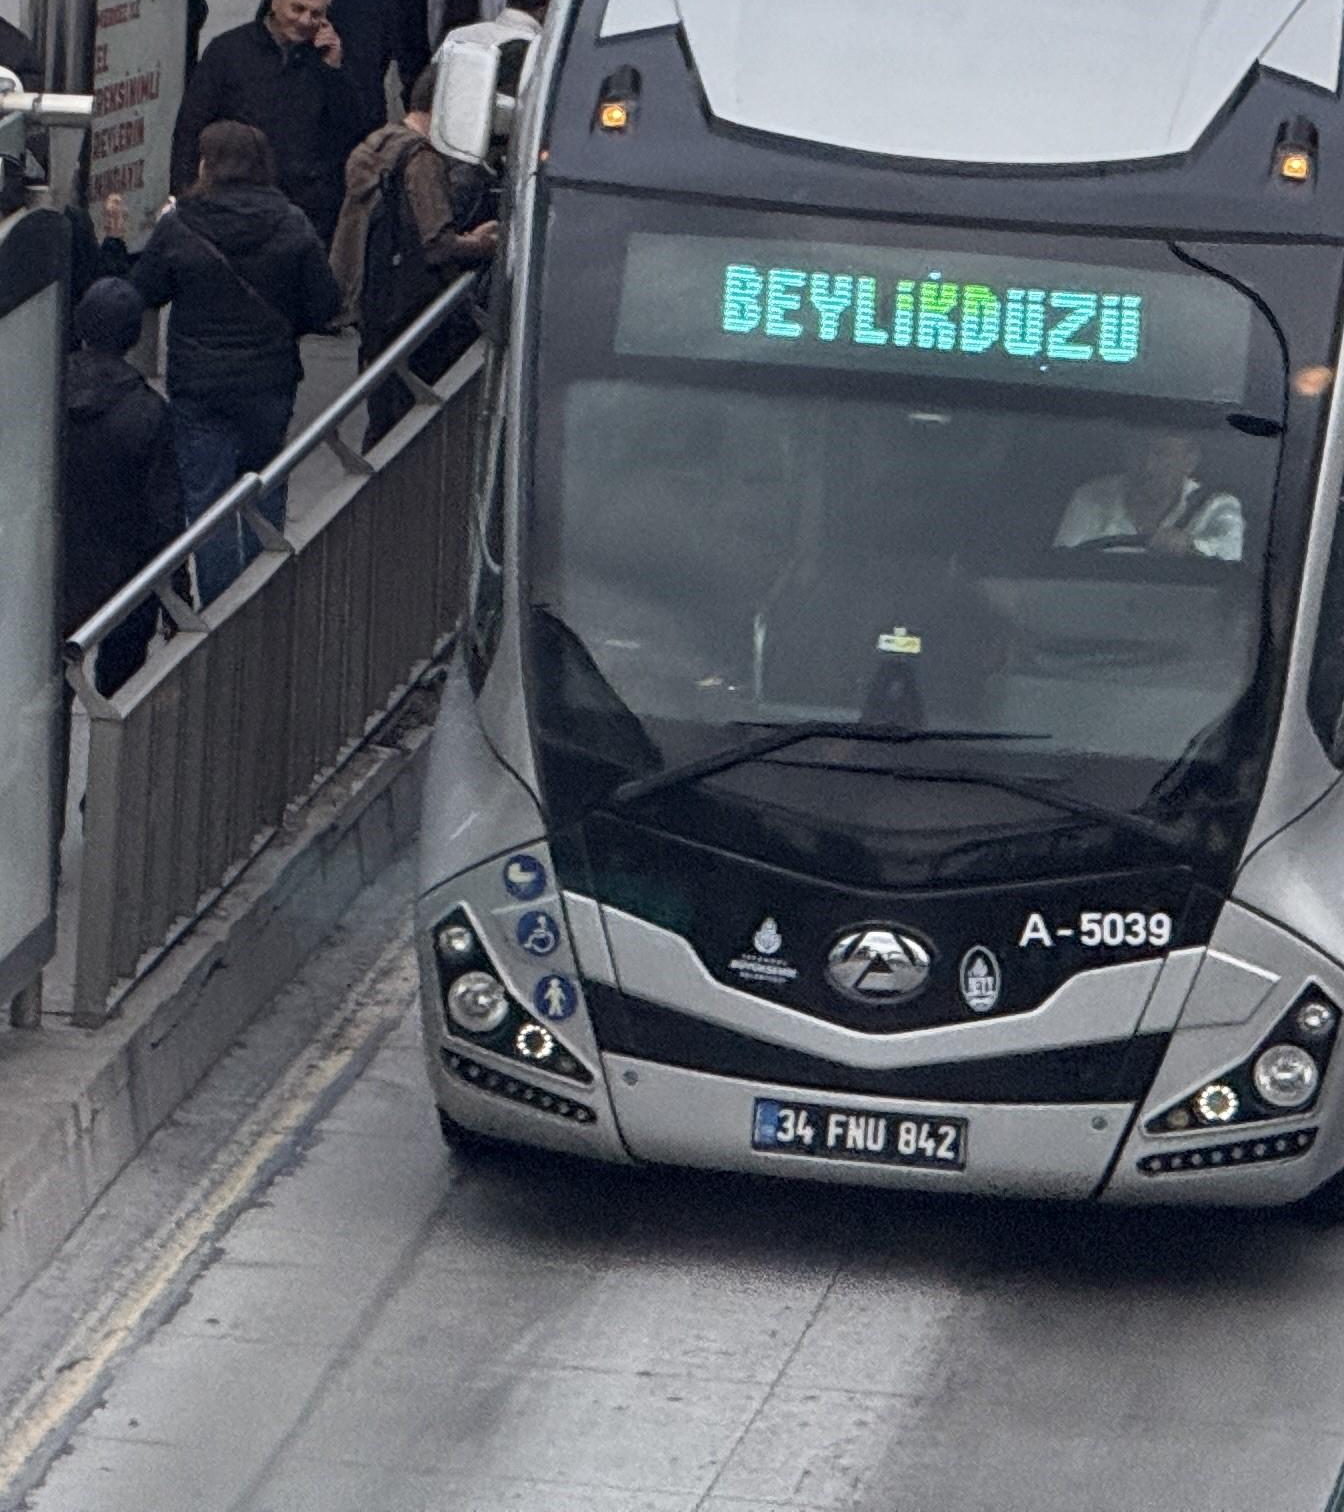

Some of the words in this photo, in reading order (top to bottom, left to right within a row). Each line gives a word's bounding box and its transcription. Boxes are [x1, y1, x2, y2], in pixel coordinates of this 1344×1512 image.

[722, 263, 1143, 364] BEYLİKDÜZÜ
[776, 1109, 814, 1145] 34
[826, 1114, 887, 1152] FNU
[898, 1121, 957, 1160] 842
